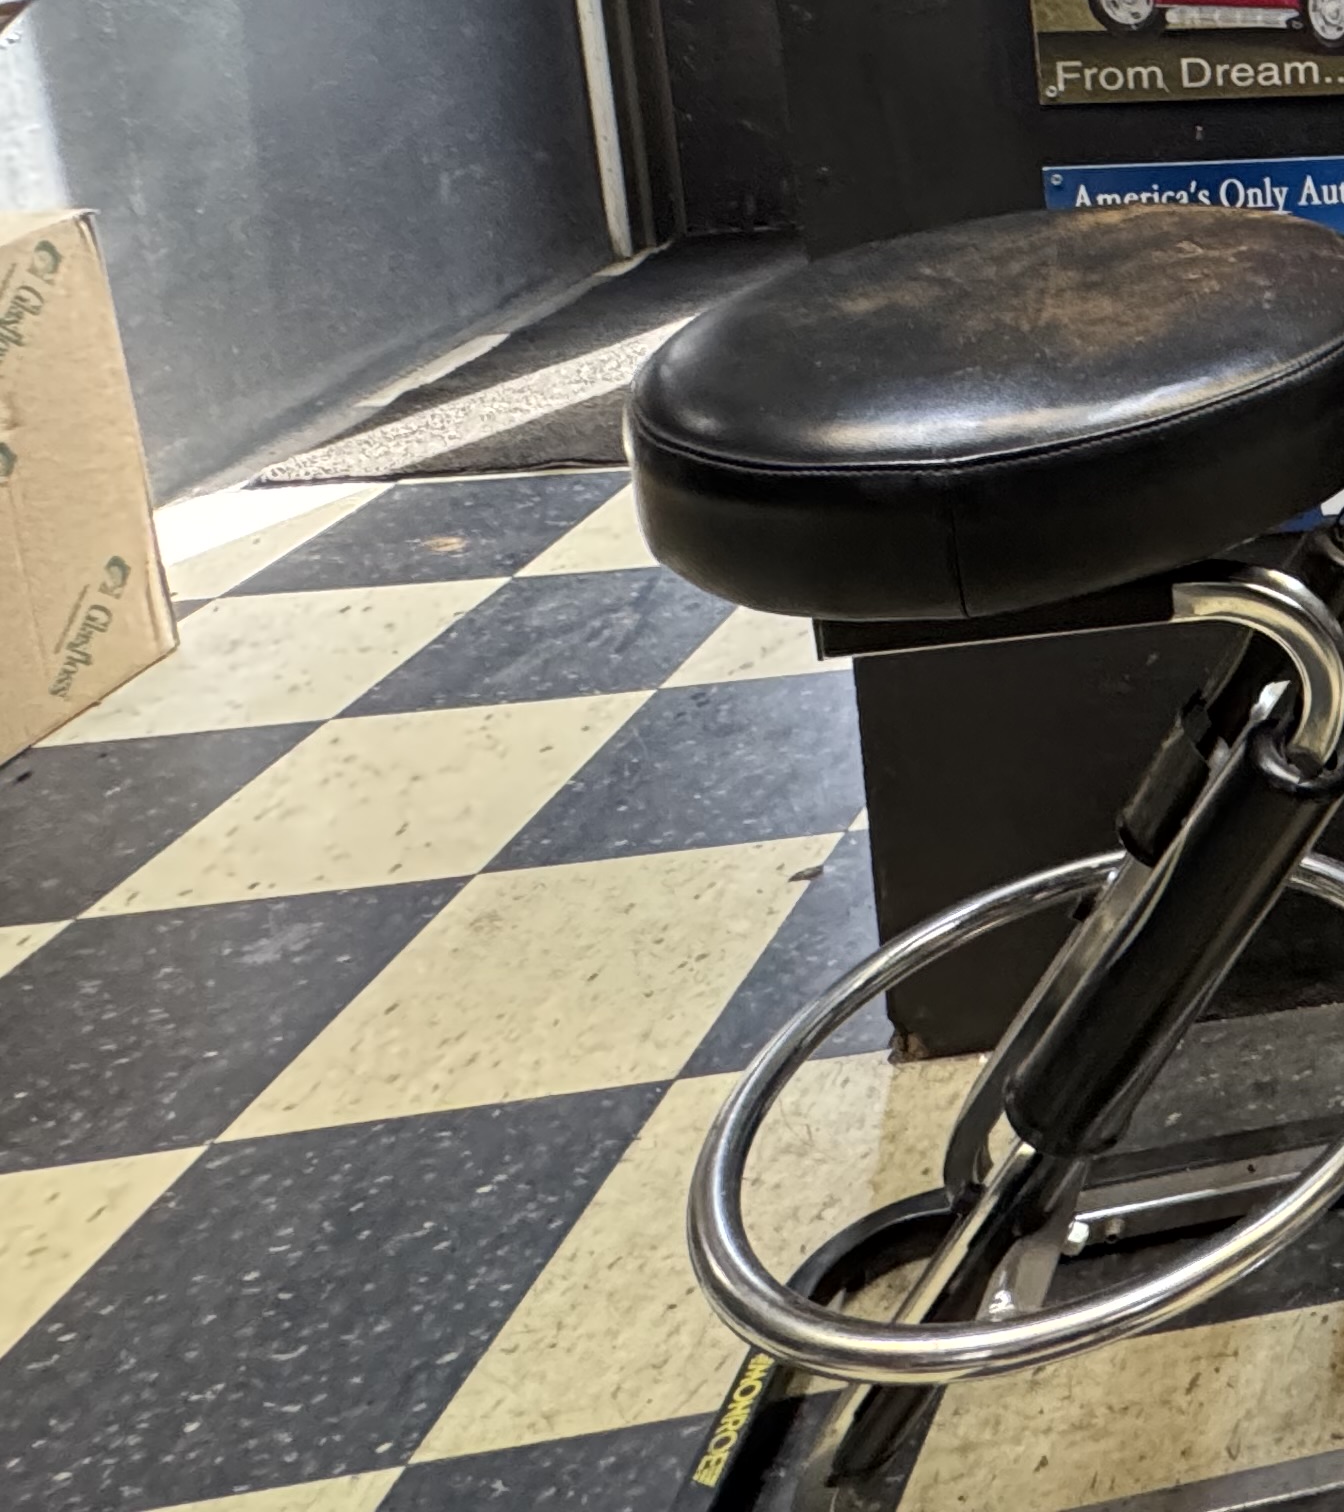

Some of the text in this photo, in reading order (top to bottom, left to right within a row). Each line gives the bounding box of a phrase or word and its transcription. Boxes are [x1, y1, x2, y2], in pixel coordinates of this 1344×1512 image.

[1055, 60, 1167, 93] From
[1219, 177, 1293, 214] Only
[692, 1353, 775, 1488] MONROE
